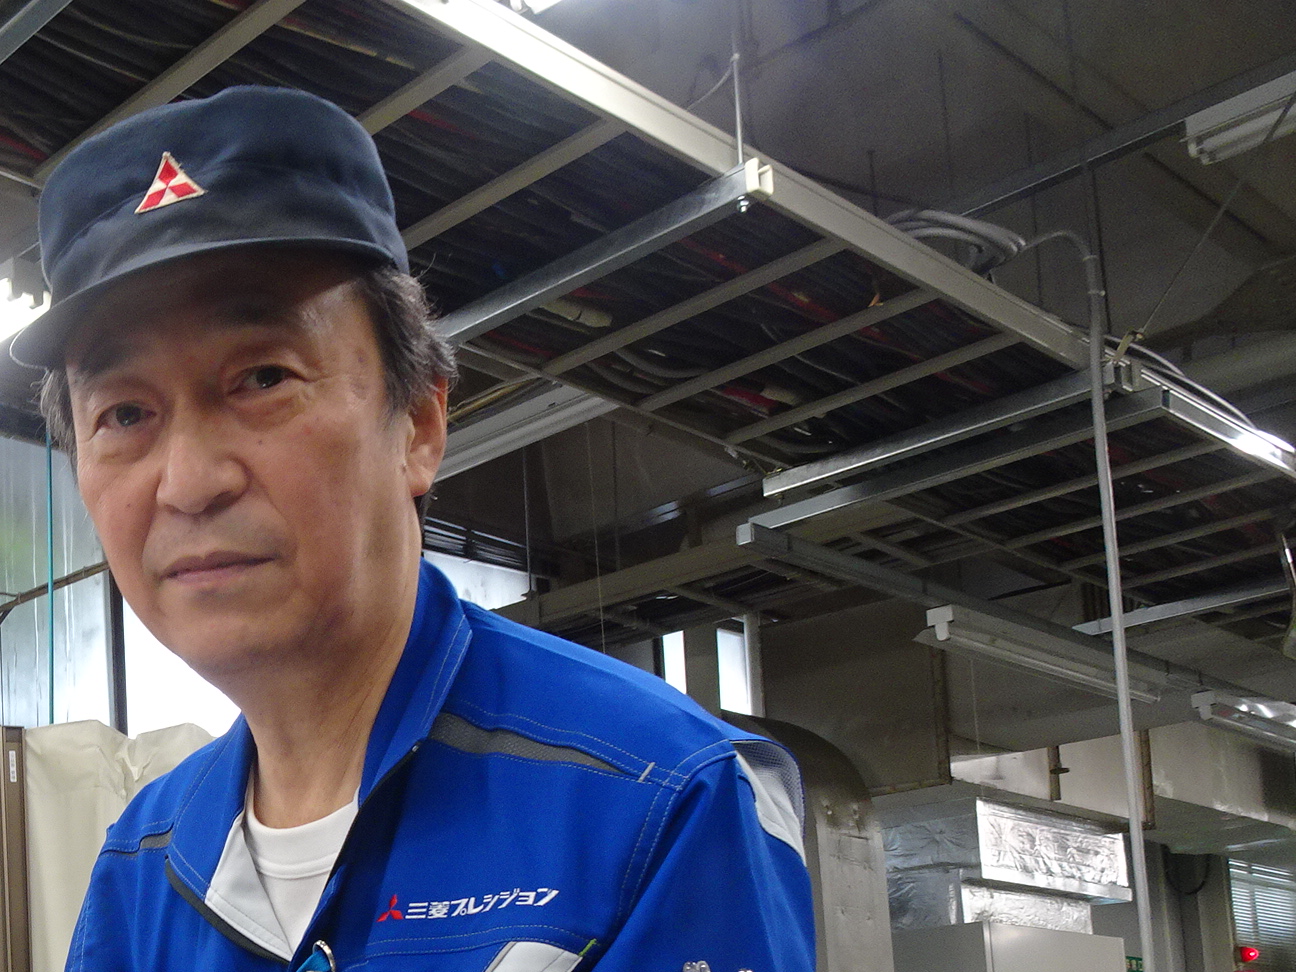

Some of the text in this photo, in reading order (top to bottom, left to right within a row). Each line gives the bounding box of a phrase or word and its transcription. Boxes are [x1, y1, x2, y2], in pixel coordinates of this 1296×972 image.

[405, 888, 559, 919] 三菱プレシジョン
